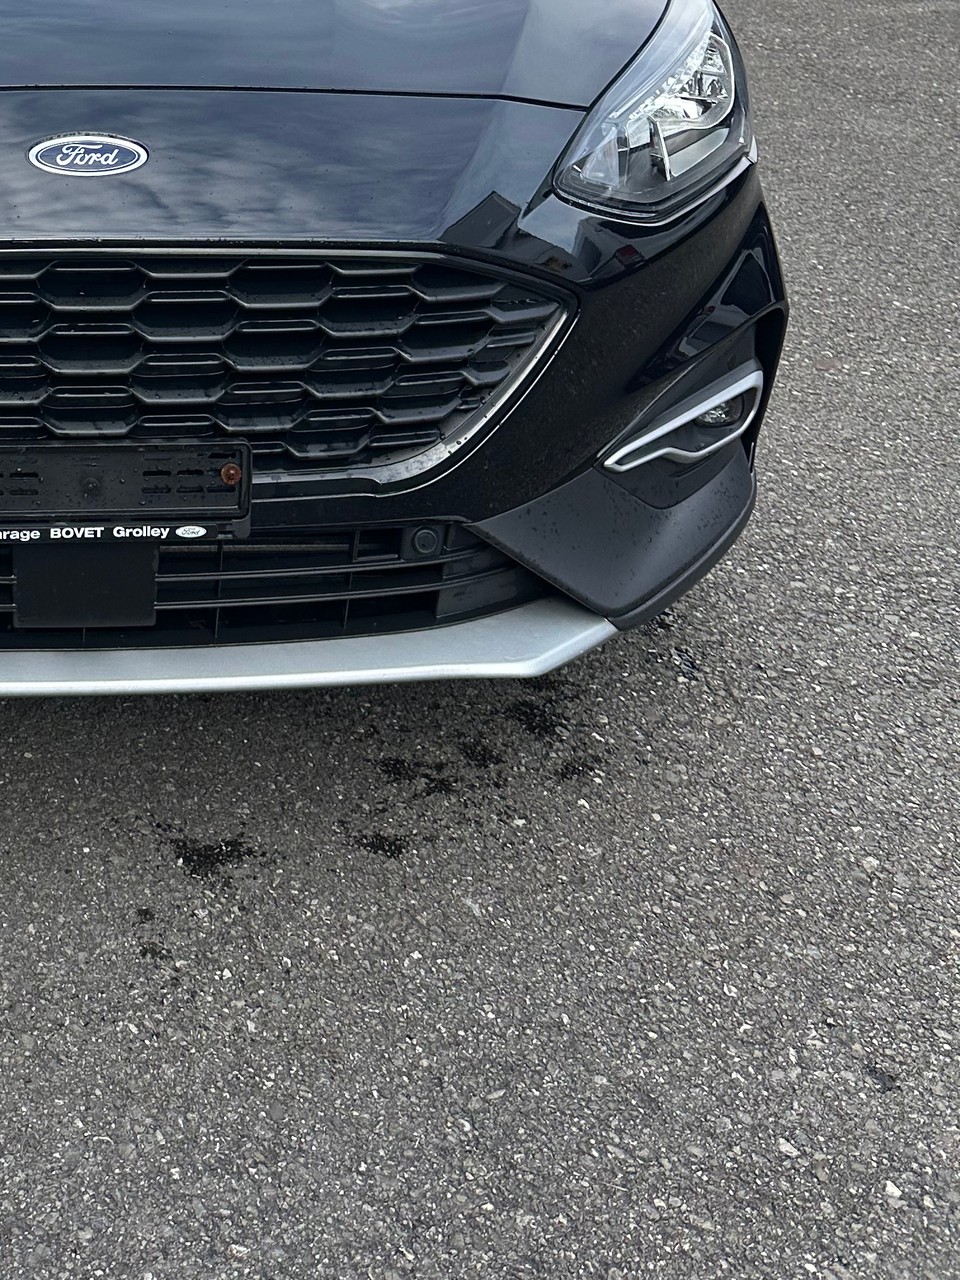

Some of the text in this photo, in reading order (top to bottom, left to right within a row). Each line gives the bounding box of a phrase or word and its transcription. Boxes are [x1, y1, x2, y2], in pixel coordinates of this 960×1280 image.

[56, 143, 119, 166] Ford
[50, 526, 104, 539] BOVET
[112, 525, 170, 539] Grolley
